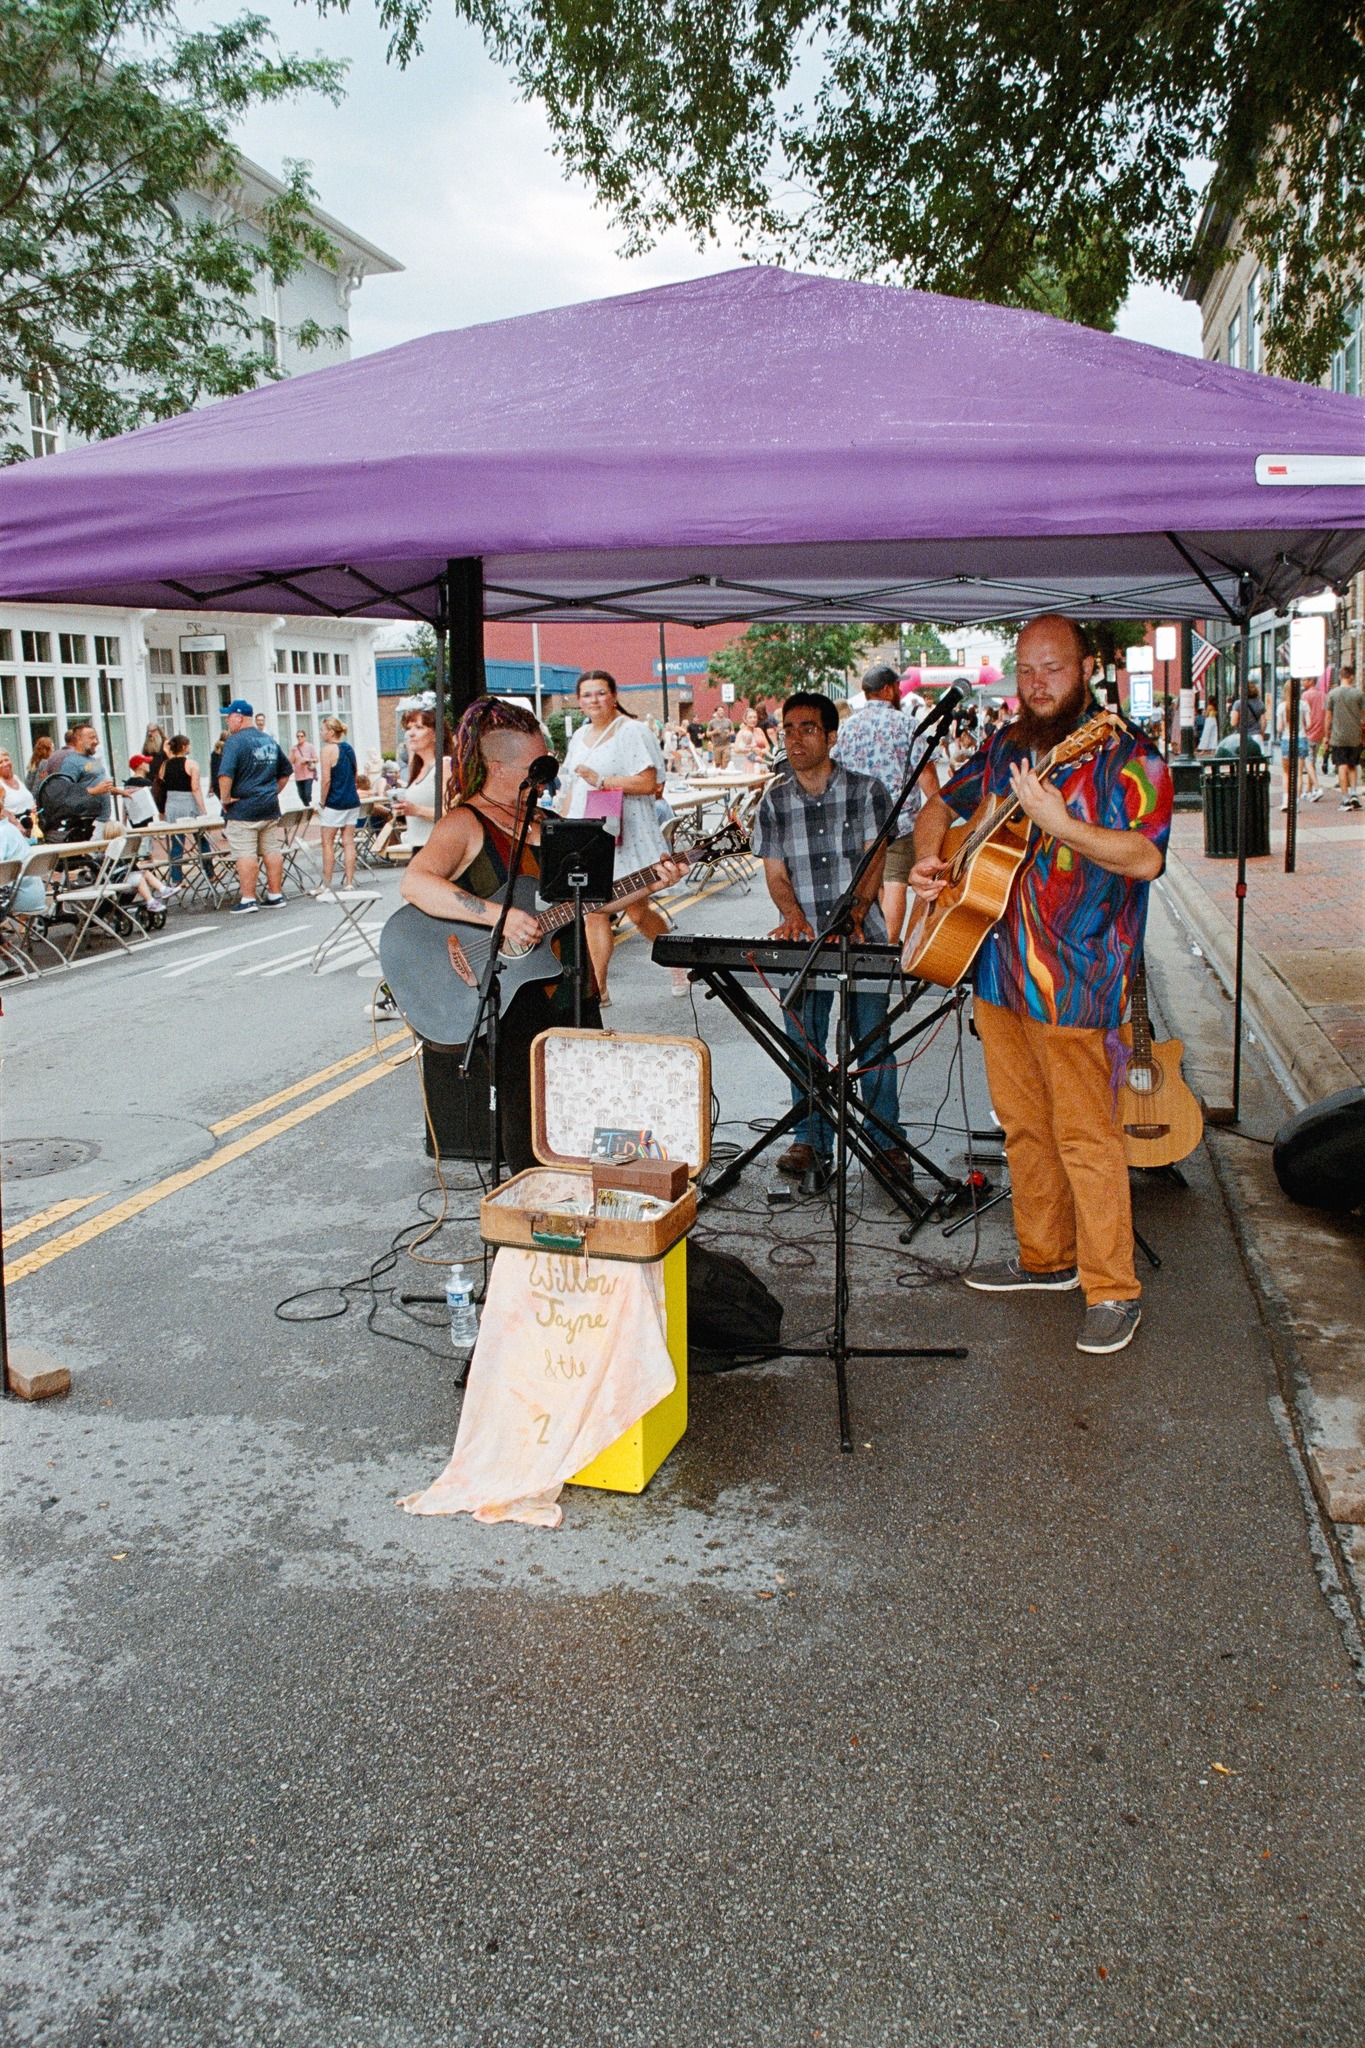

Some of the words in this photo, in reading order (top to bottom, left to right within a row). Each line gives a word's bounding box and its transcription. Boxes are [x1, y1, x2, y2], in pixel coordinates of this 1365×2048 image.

[665, 662, 682, 671] PNC
[683, 661, 706, 670] BANK
[525, 1252, 619, 1295] Willow
[532, 1291, 609, 1344] Jayne
